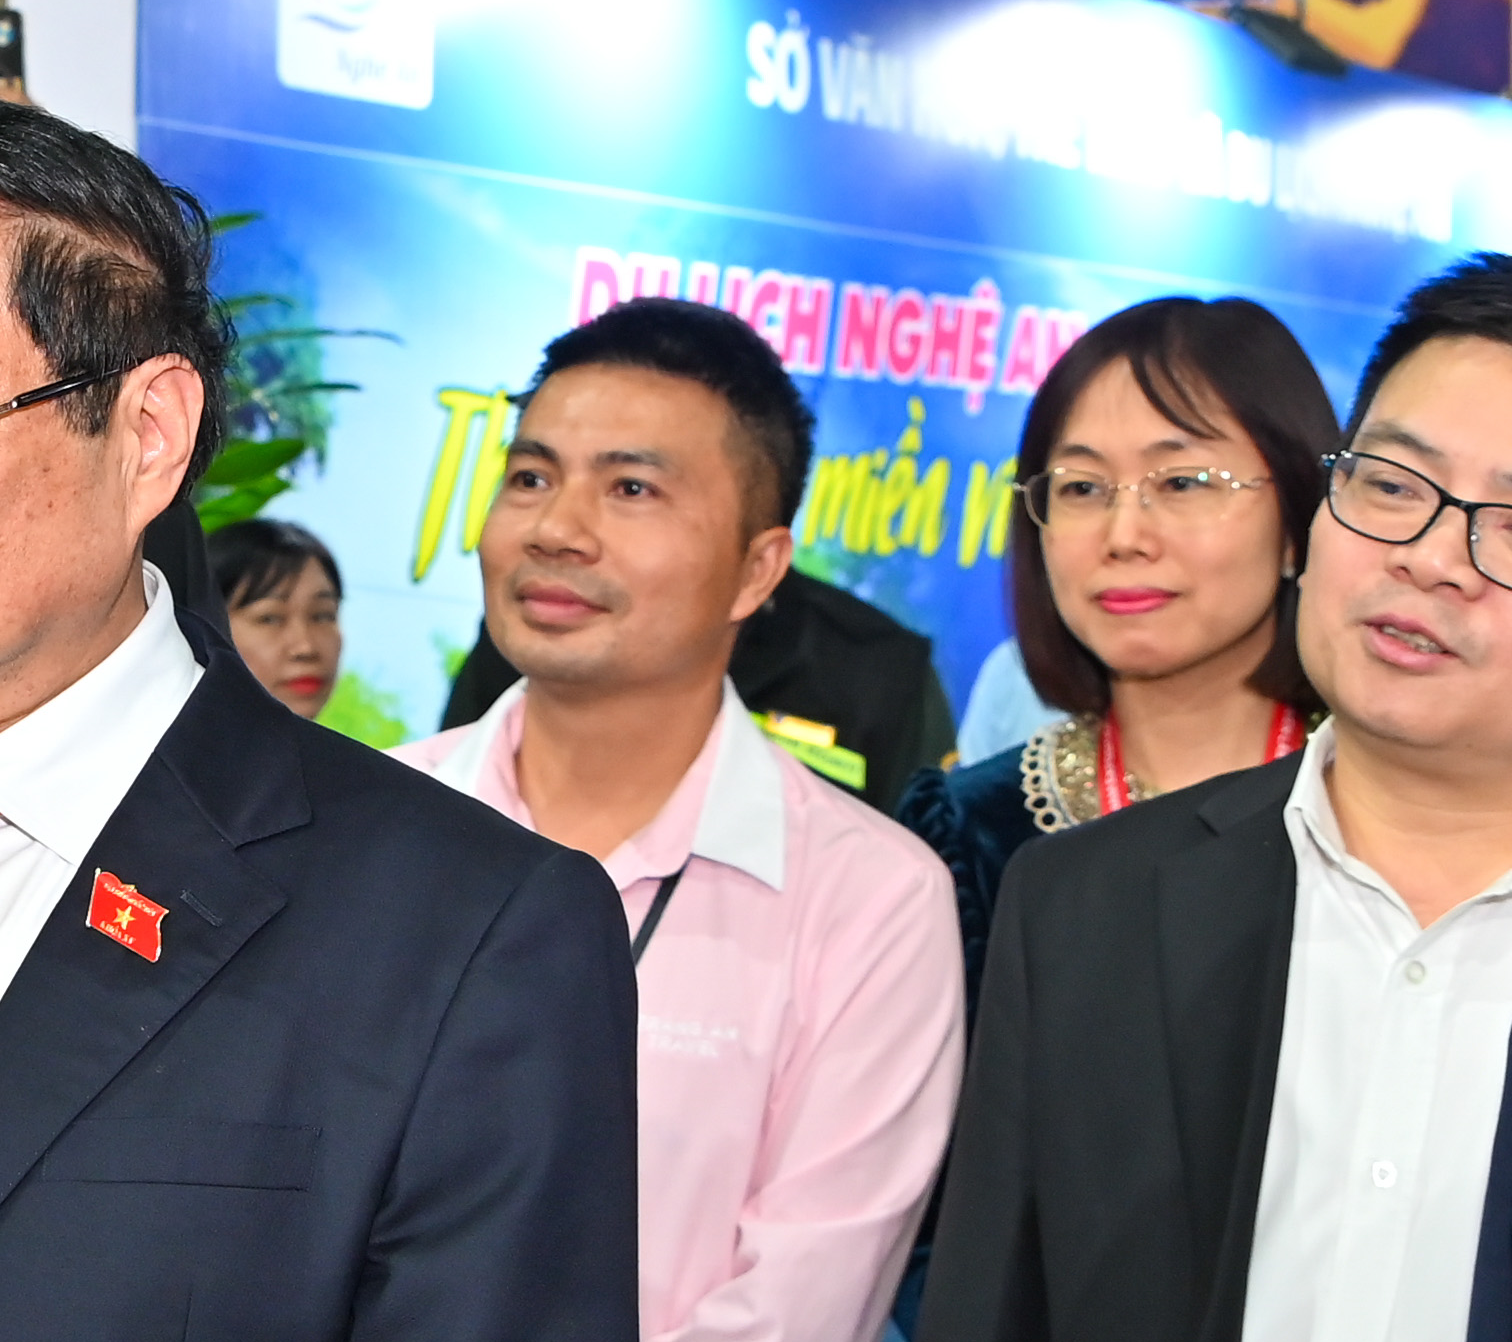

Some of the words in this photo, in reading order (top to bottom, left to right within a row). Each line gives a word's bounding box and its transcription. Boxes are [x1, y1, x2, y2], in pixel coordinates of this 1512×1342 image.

[745, 8, 812, 114] SỞ
[834, 277, 1003, 415] NGHỆ
[801, 397, 952, 558] miền
